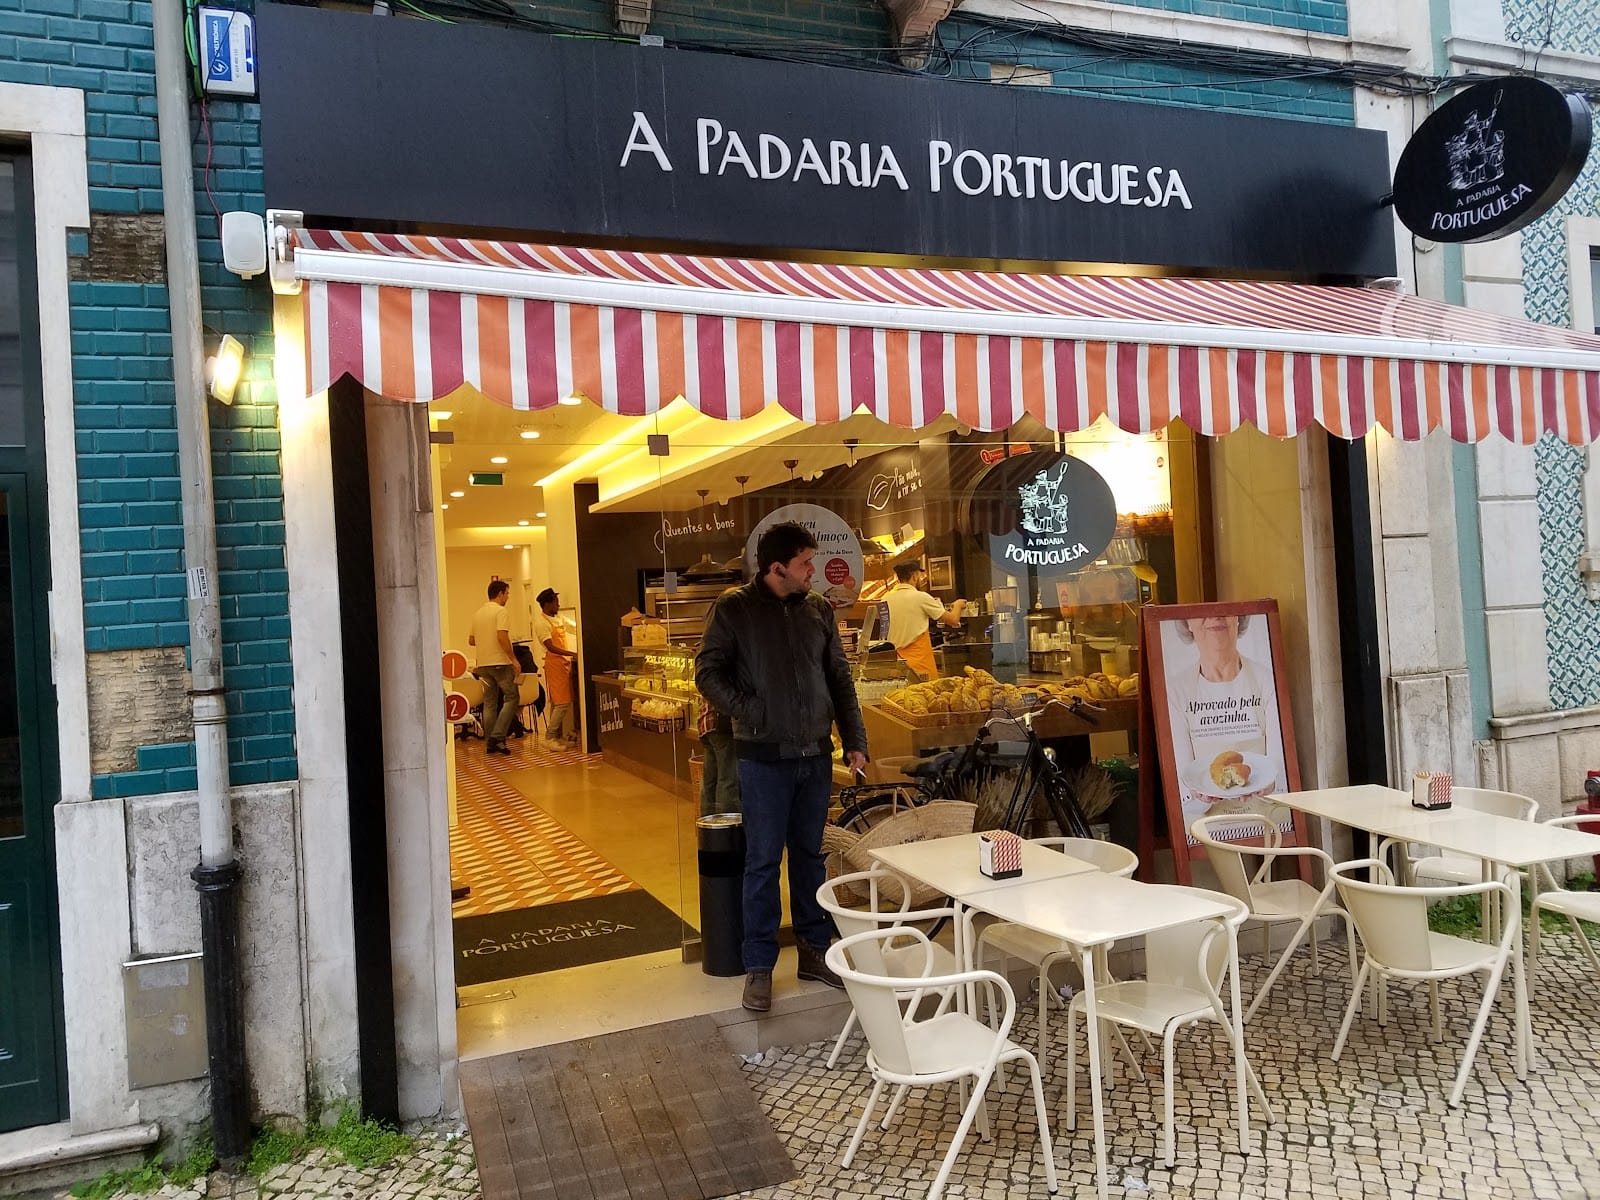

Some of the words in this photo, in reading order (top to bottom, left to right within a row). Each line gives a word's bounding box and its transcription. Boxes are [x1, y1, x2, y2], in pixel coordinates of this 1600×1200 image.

[619, 111, 674, 171] A
[696, 117, 909, 191] PADARIA
[929, 140, 1193, 210] PORTUGUESA
[1431, 183, 1533, 230] PORTUGUESA
[1456, 198, 1465, 208] A
[1466, 184, 1502, 204] PADARIA
[663, 516, 703, 537] Quentes
[705, 523, 712, 531] e
[713, 512, 735, 530] bons
[1005, 542, 1090, 566] PORTUGUESA
[1027, 538, 1035, 547] A
[1036, 537, 1065, 546] PADARIA
[450, 699, 460, 718] 2
[1185, 696, 1238, 715] Aprovado
[1239, 694, 1262, 711] pela
[1200, 710, 1251, 726] avozinha.
[461, 923, 637, 959] PORTUGUESA
[478, 937, 496, 945] A
[511, 919, 613, 940] PADARIA
